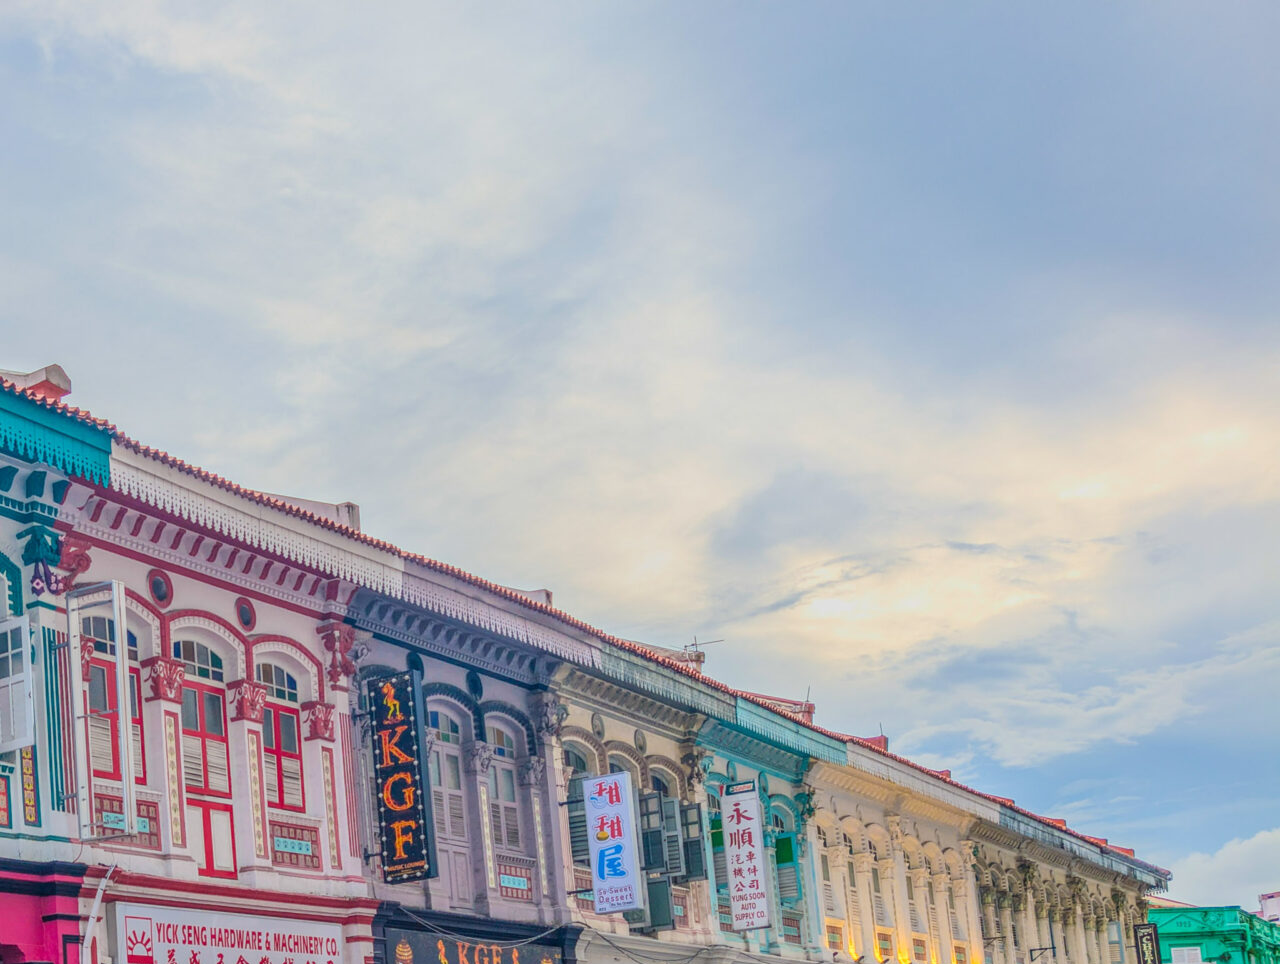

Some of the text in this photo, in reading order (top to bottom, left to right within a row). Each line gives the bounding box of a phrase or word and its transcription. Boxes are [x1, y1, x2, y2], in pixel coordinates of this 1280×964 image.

[591, 780, 626, 880] 甜甜屋
[599, 893, 633, 904] Dessert
[732, 892, 765, 902] YUNG SOON
[741, 903, 757, 911] AUTO
[735, 911, 755, 922] SUPPLY
[156, 922, 340, 957] YICK SENG HARDWARE & MACHINERY CO.
